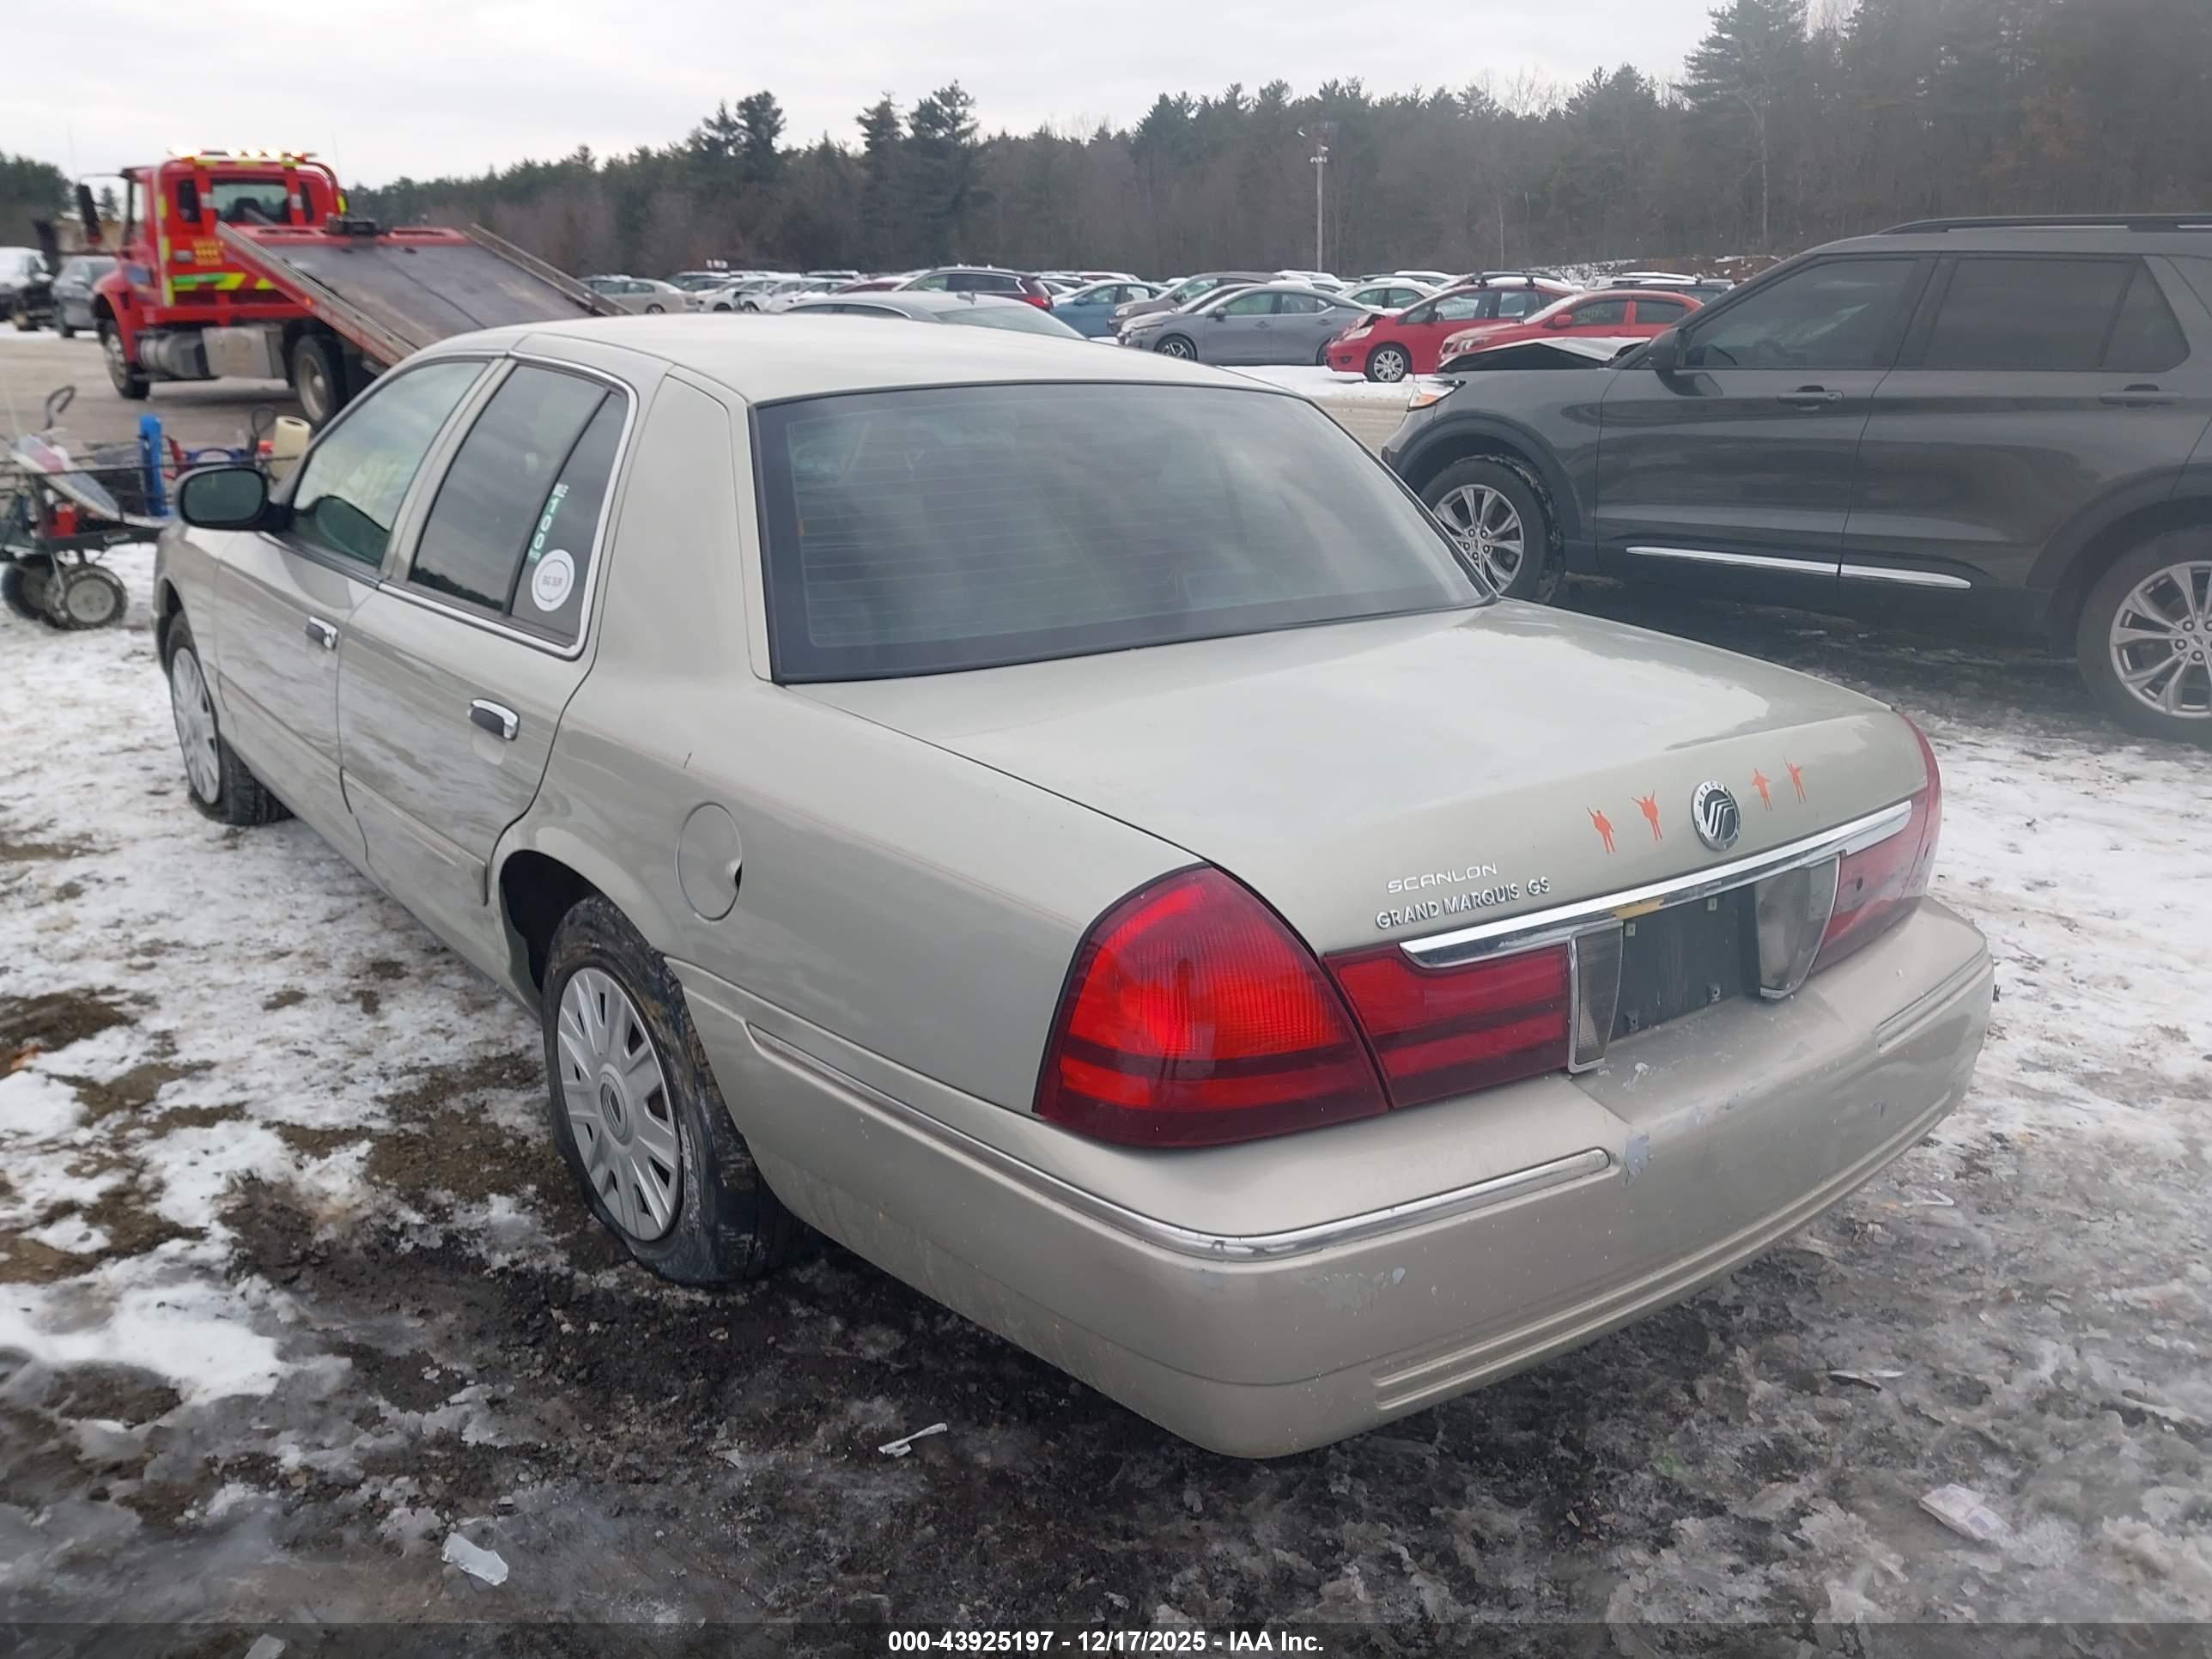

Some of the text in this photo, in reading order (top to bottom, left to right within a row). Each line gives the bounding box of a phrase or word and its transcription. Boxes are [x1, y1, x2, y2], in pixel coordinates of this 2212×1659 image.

[1387, 861, 1498, 894] SCANLON
[1376, 876, 1551, 929] GRAND MARQUIS GS
